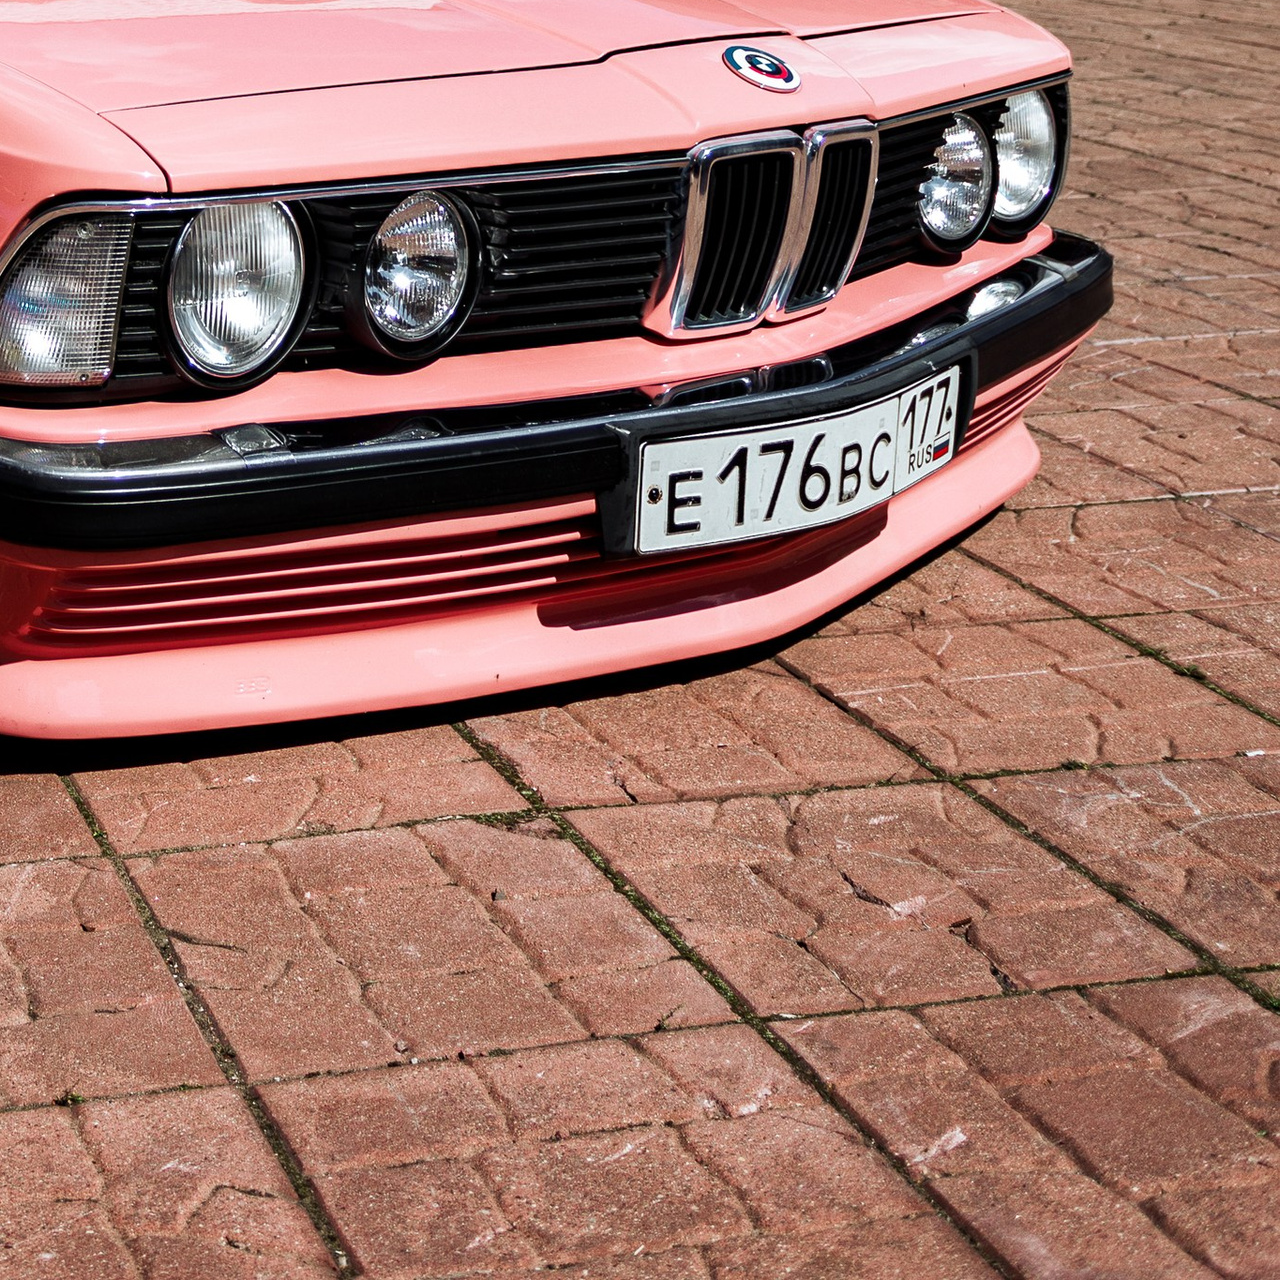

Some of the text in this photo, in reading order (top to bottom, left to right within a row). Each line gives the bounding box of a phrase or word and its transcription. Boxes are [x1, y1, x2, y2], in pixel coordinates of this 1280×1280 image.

[665, 375, 951, 536] E176BC 177
[907, 444, 933, 475] RUS
